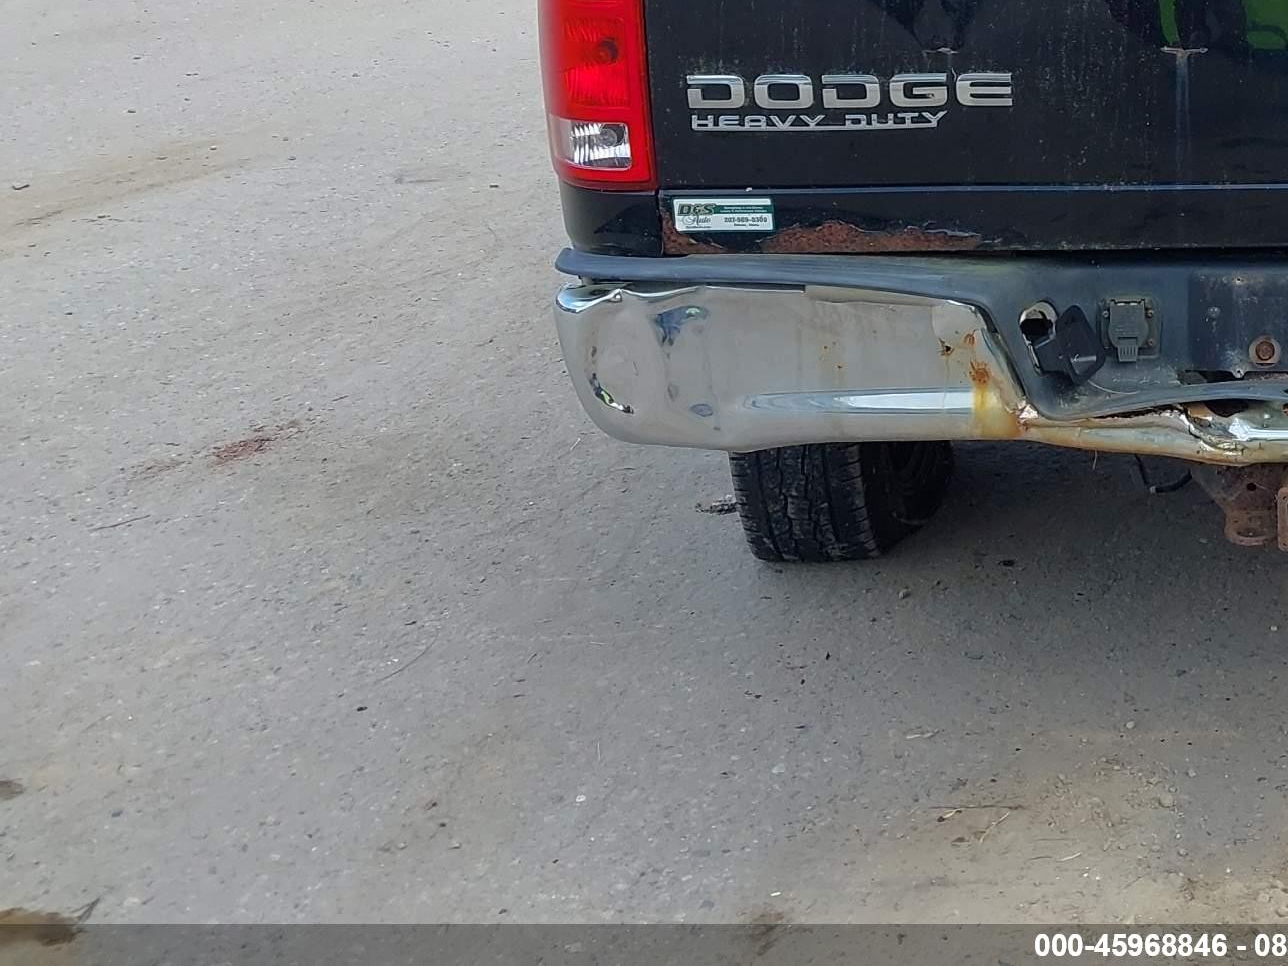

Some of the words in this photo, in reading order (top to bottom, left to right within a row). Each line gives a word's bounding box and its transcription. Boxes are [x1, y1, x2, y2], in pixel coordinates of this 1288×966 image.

[686, 72, 1013, 109] DODGE
[691, 114, 826, 130] HEAVY
[845, 111, 947, 129] DUTY
